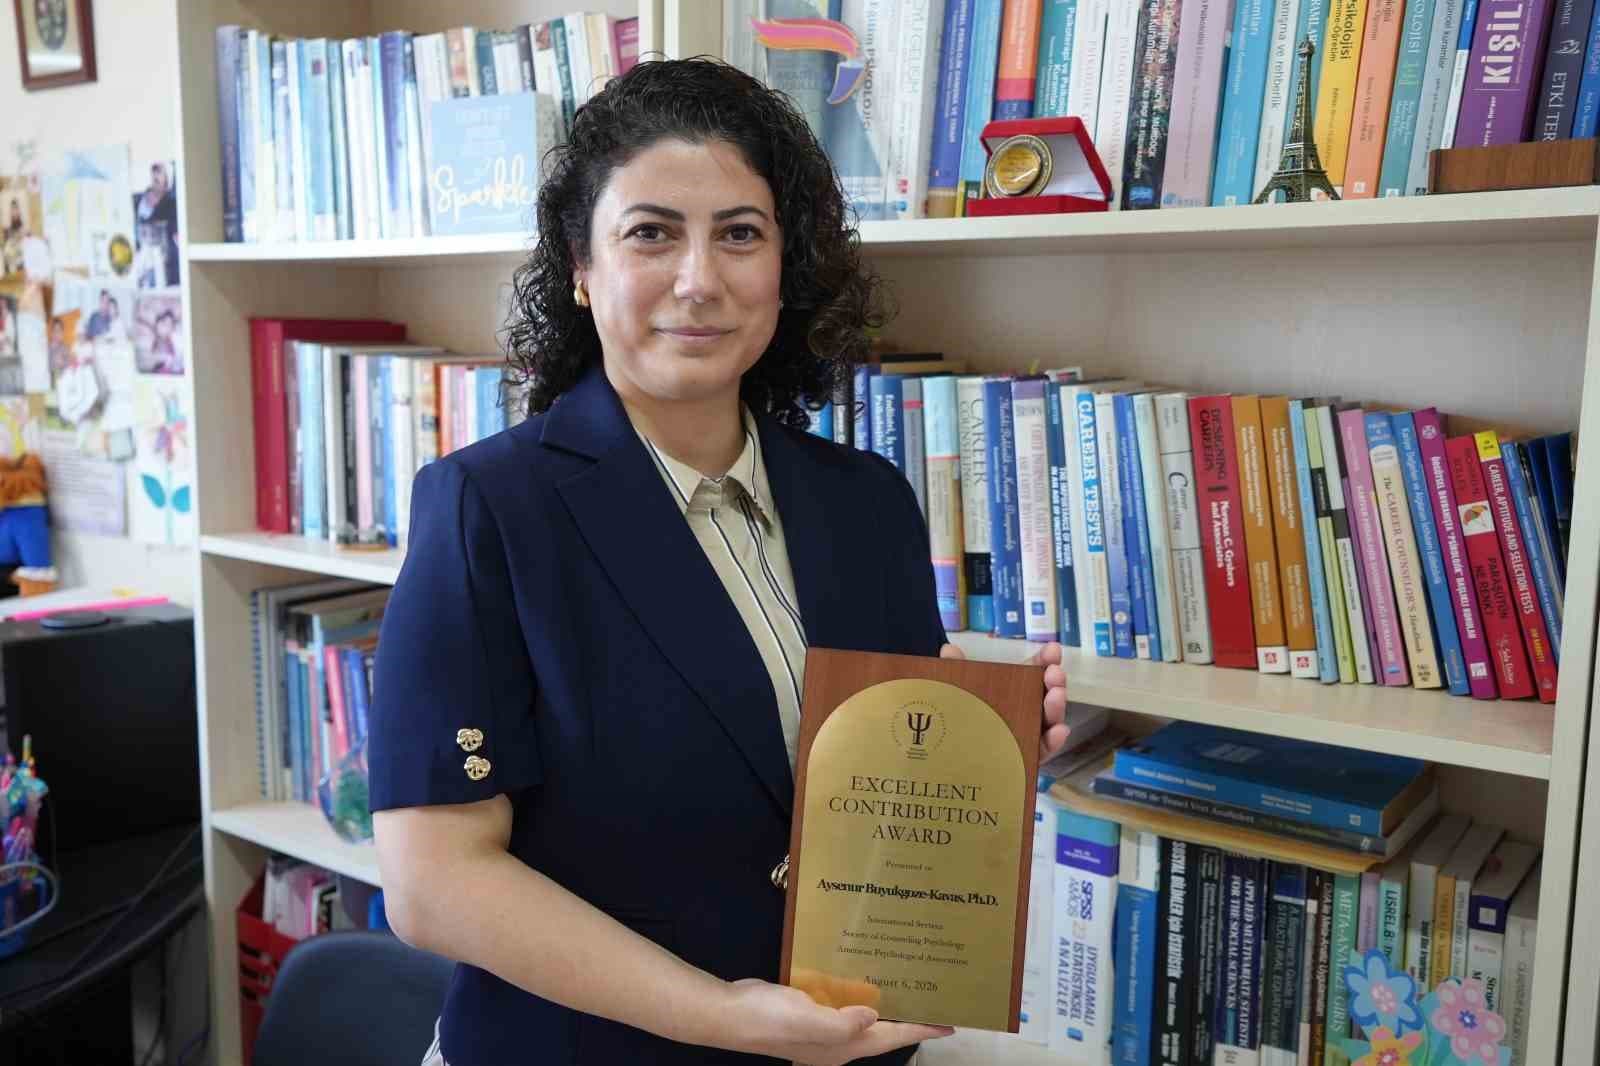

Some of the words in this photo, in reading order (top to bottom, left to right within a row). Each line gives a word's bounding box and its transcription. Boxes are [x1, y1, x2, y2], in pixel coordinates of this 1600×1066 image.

[1480, 0, 1524, 84] KİŞİL
[971, 397, 988, 486] CAREER
[1078, 399, 1099, 482] CAREER
[1085, 483, 1103, 547] TESTS
[1211, 500, 1220, 519] and
[1220, 499, 1230, 538] Norman
[1386, 491, 1403, 537] CAREER
[1493, 495, 1512, 531] APTITUDE
[1212, 519, 1224, 569] Associates
[1223, 538, 1232, 549] C.
[1503, 530, 1518, 551] AND
[1224, 549, 1236, 588] Gysbers
[1508, 550, 1527, 592] SELECTION
[1518, 591, 1535, 615] TESTS
[850, 775, 982, 802] EXCELLENT
[829, 796, 1000, 827] CONTRIBUTION
[871, 824, 952, 845] AWARD
[885, 859, 922, 871] Presented
[1171, 841, 1186, 875] SOSYAL
[816, 878, 865, 895] Aysenur
[967, 893, 1000, 907] Ph.D.
[1079, 880, 1094, 921] SPSS
[1231, 875, 1241, 897] FOR
[1244, 879, 1255, 922] APPLIED
[1230, 898, 1241, 920] THE
[838, 944, 872, 955] American
[874, 948, 924, 962] Psychological
[842, 928, 868, 940] Society
[870, 931, 878, 940] of
[923, 937, 966, 951] Psychology
[1228, 919, 1240, 959] SOCIAL
[1239, 922, 1255, 998] MULTIVARIATE
[863, 974, 899, 991] August
[1083, 945, 1100, 1027] UYGULAMALI
[1226, 959, 1238, 1008] SCIENCES
